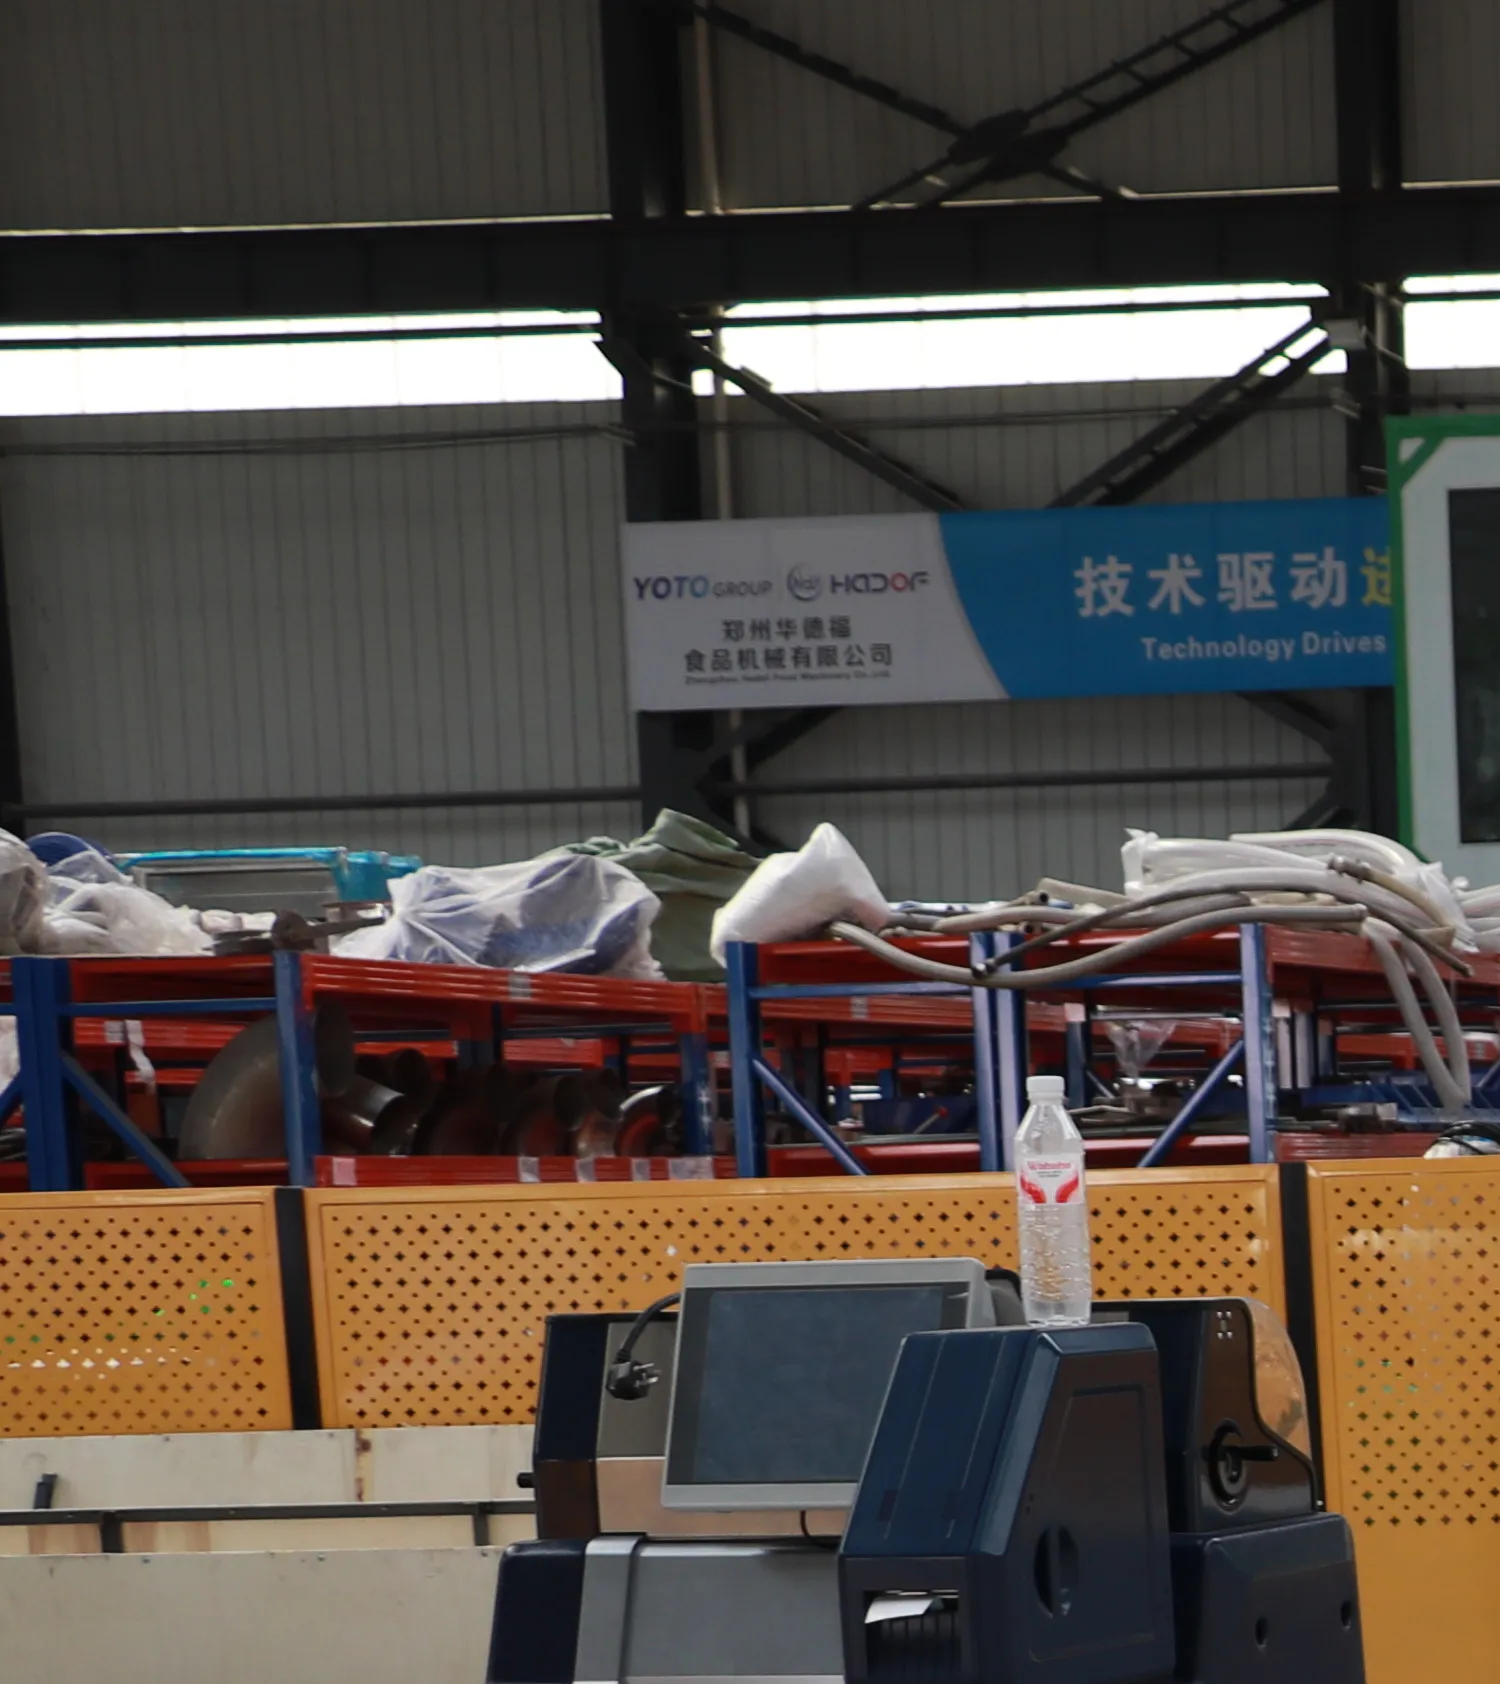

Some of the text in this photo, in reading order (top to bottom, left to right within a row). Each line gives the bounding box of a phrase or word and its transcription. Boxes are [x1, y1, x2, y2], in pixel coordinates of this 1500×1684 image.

[633, 574, 710, 600] YOTO
[712, 580, 774, 598] GROUP
[721, 615, 852, 643] 郑州华德福
[684, 643, 893, 673] 食品机械有限公司
[1140, 629, 1387, 662] Technology Drives
